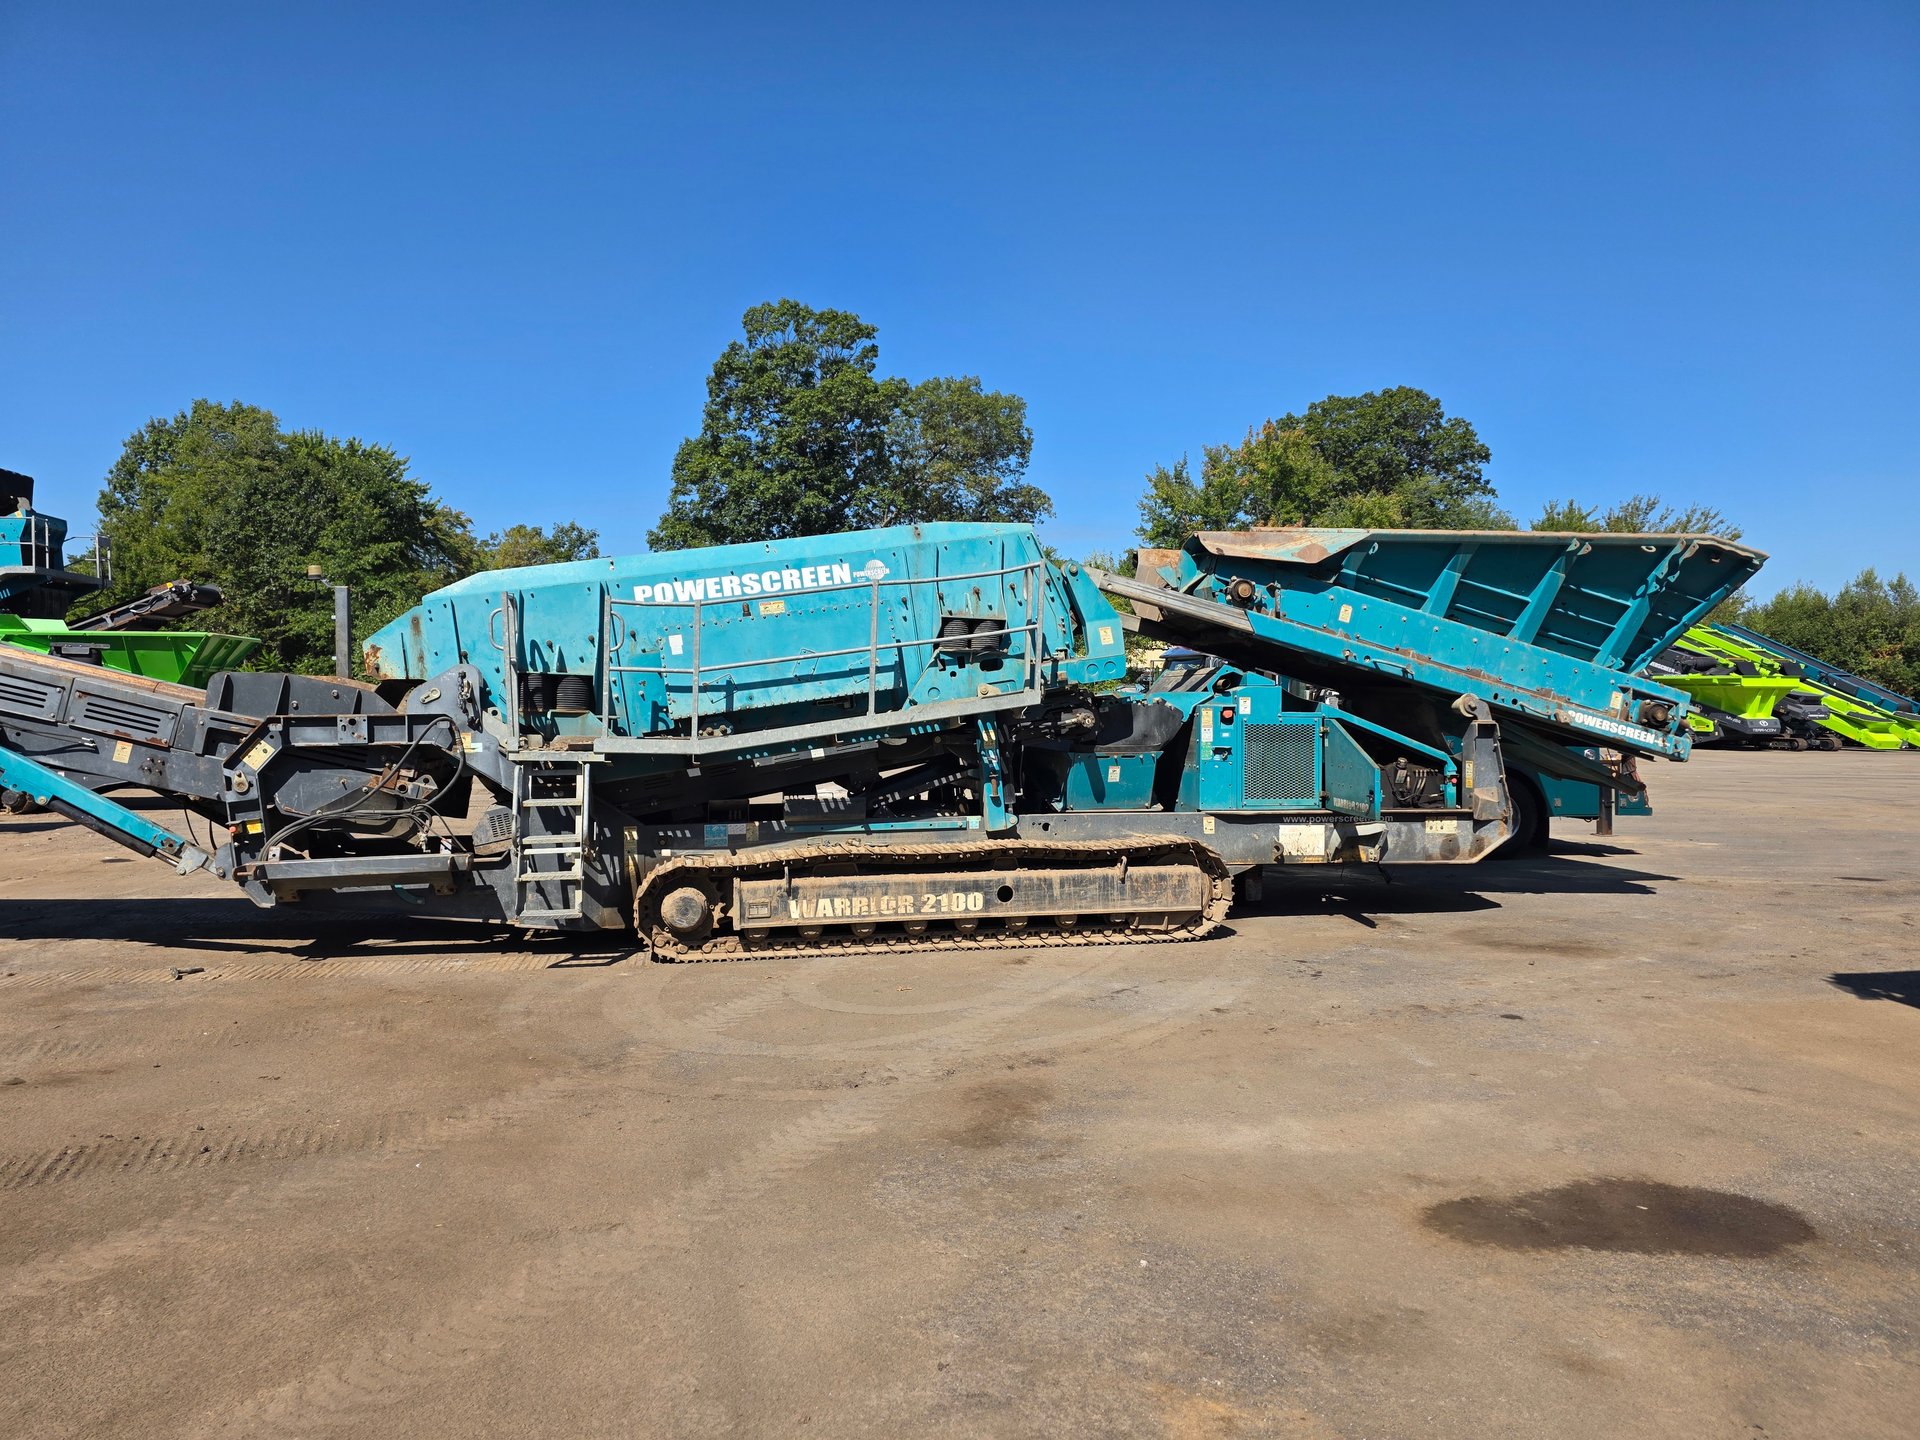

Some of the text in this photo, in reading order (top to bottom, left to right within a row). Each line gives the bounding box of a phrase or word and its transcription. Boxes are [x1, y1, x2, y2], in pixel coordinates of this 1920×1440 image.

[633, 562, 851, 602] POWERSCREEN
[1282, 814, 1394, 824] www.powerscreen.om
[787, 892, 984, 919] WARRIOR 2100
